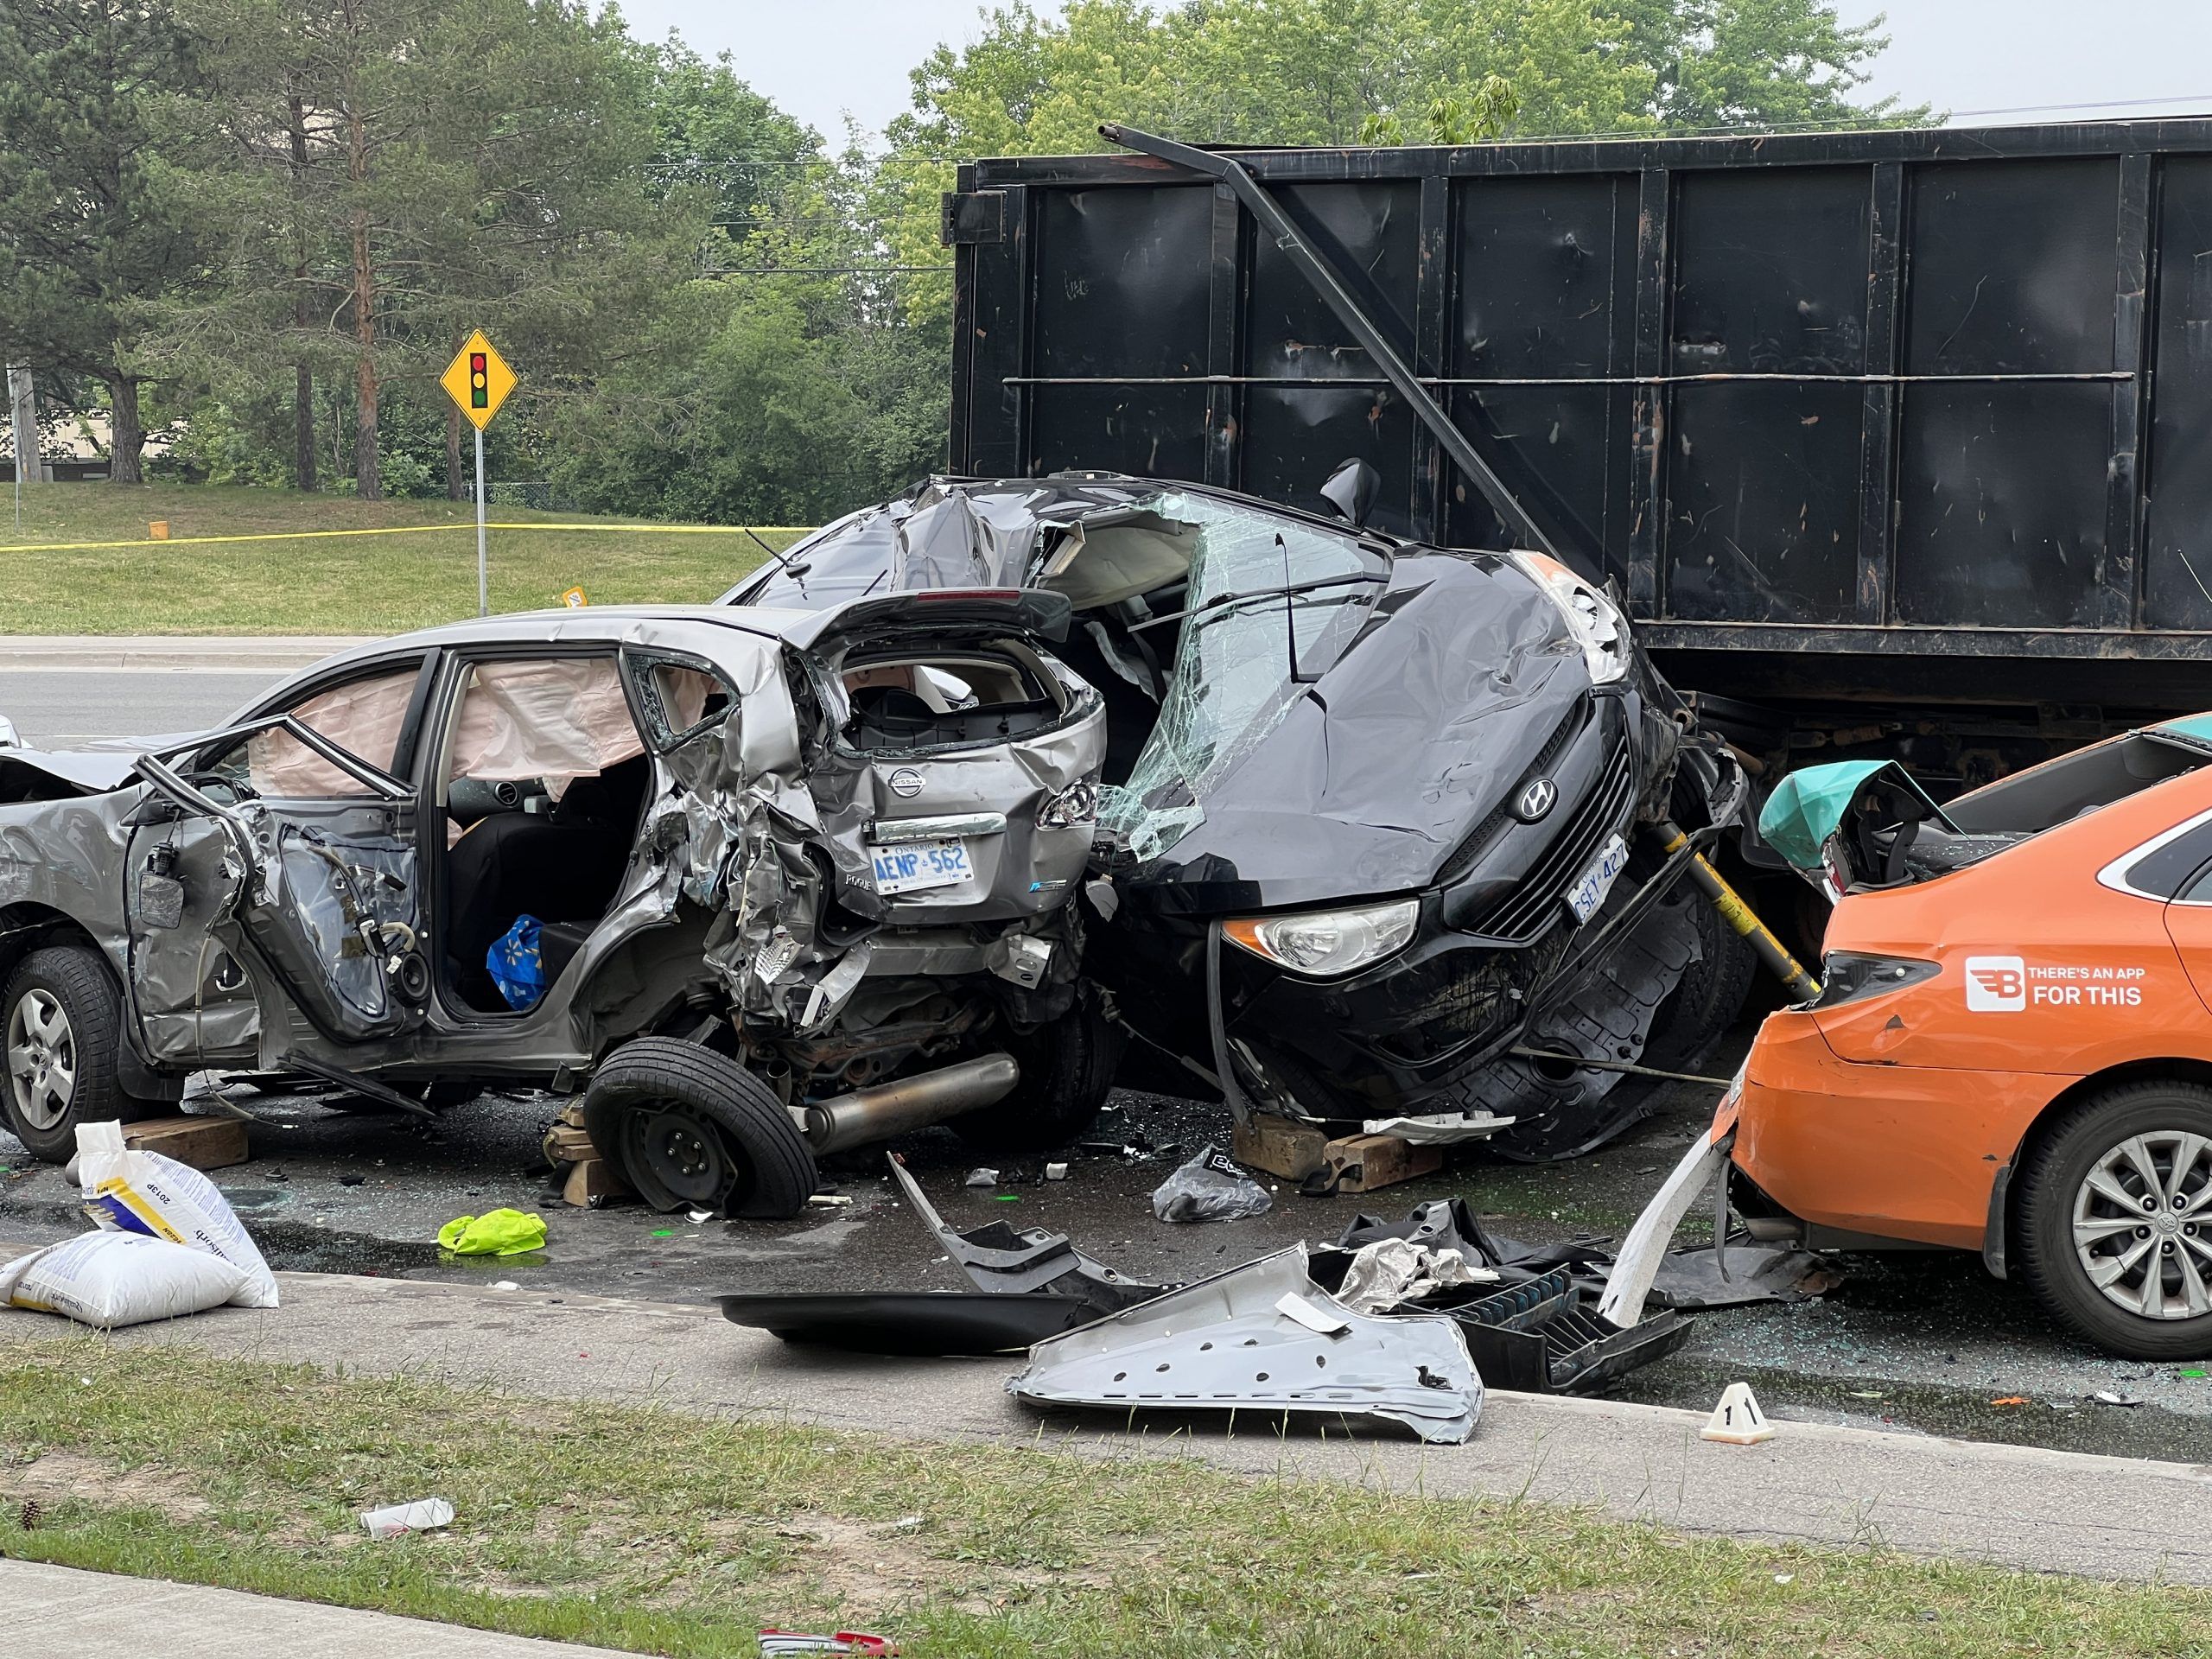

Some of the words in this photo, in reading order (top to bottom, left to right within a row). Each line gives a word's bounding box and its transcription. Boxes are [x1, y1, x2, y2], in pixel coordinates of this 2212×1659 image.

[895, 842, 934, 855] ONTARIO
[874, 852, 918, 881] AENP
[927, 847, 967, 874] 562
[845, 874, 872, 891] ROGUE
[1574, 874, 1599, 921] CSEY
[1604, 842, 1625, 879] 427
[2027, 967, 2090, 979] THERE'S
[2092, 967, 2113, 979] AN
[2115, 967, 2146, 980] APP
[2033, 986, 2082, 1005] FOR
[2085, 986, 2143, 1006] THIS
[147, 1183, 171, 1205] 2013P
[195, 1229, 237, 1266] lisorb
[1725, 1405, 1732, 1426] 1
[1744, 1396, 1758, 1426] 1
